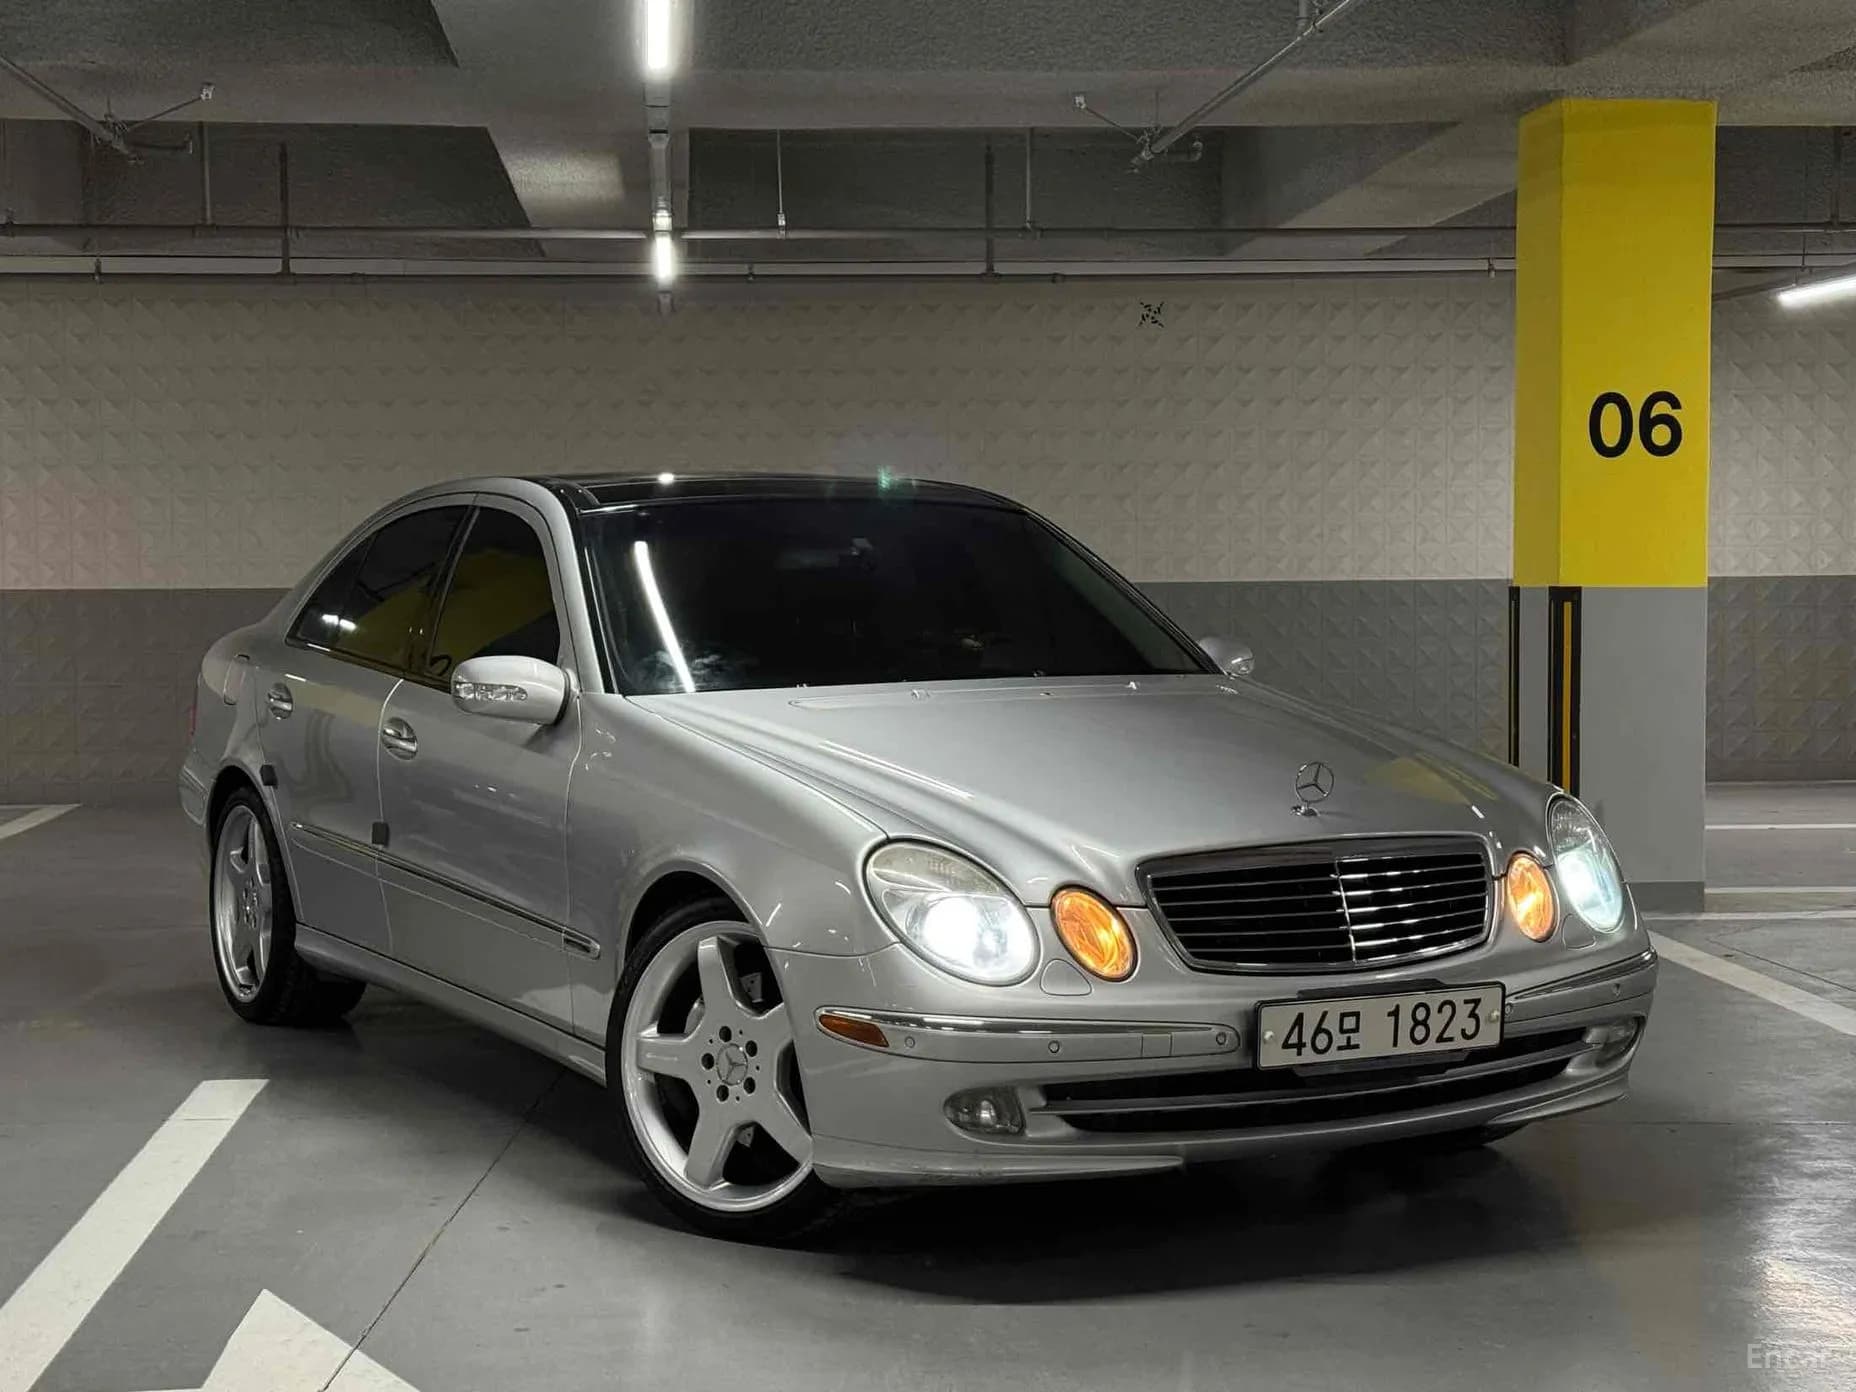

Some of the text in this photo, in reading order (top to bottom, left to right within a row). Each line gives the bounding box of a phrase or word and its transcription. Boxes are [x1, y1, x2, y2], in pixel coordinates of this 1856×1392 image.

[1588, 390, 1683, 458] 06
[1281, 998, 1482, 1056] 46모 1823
